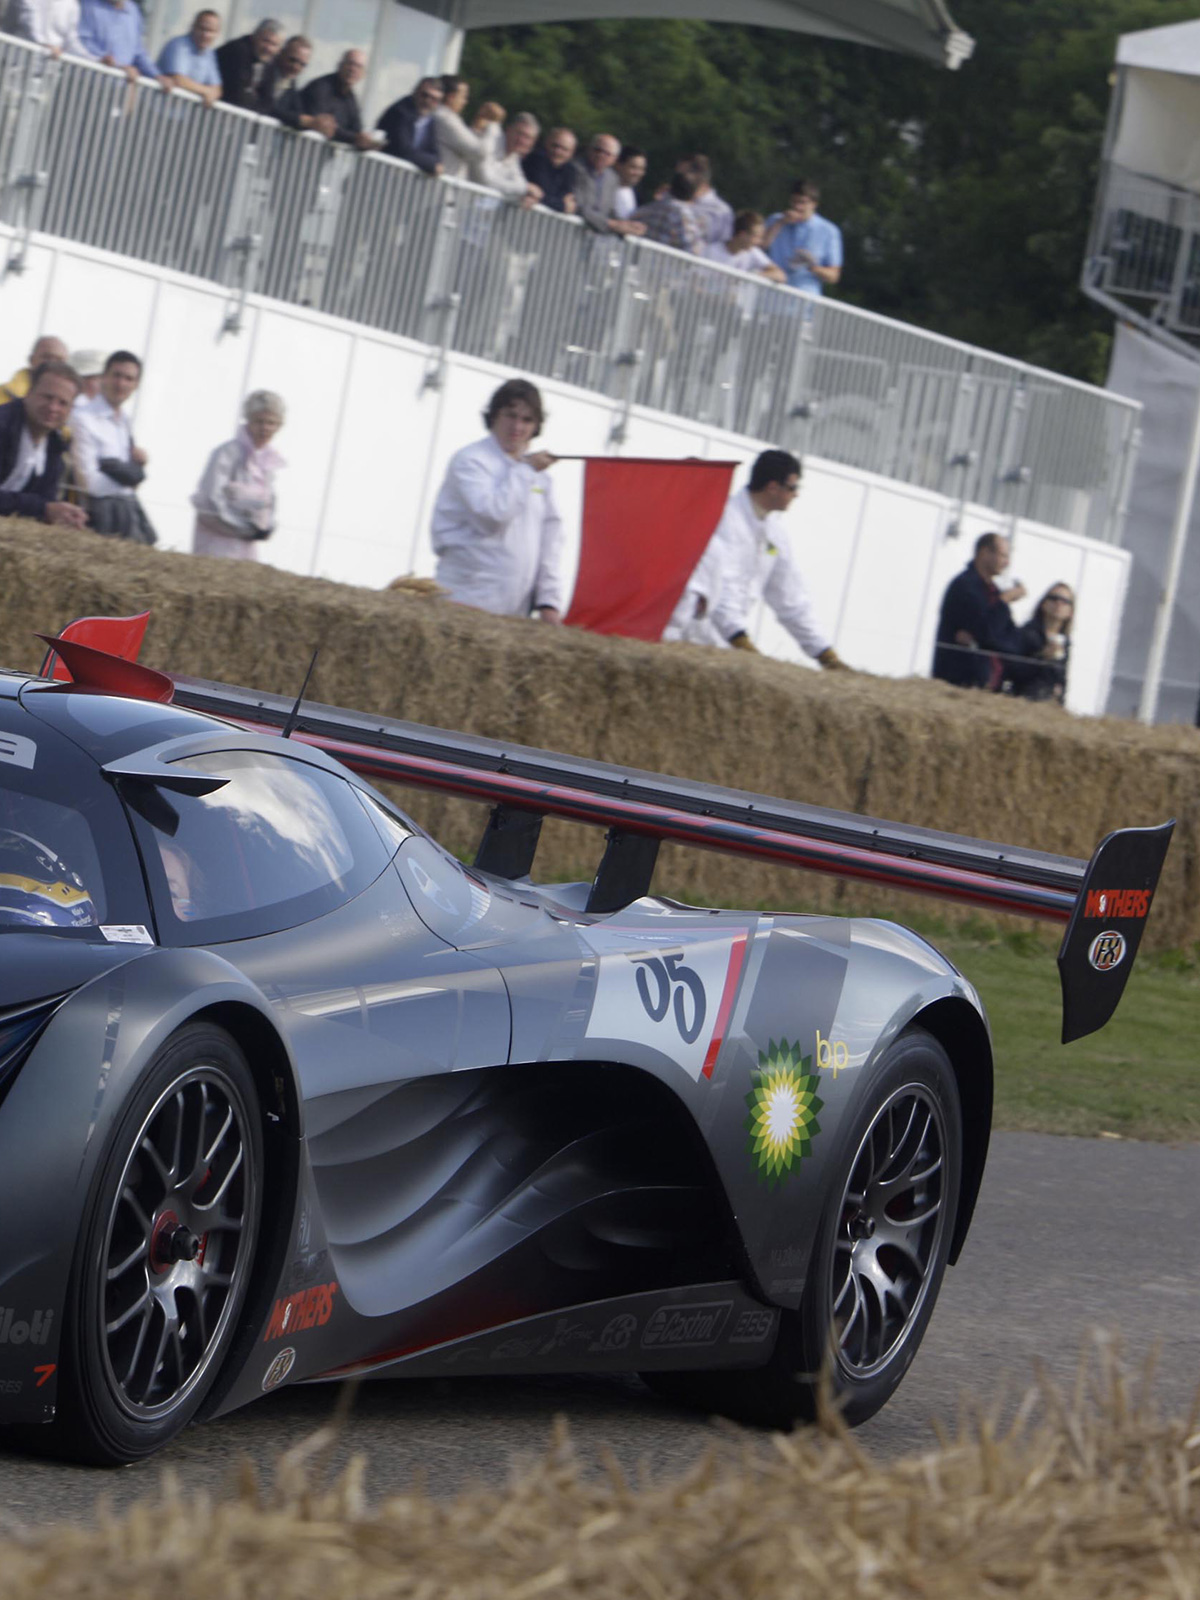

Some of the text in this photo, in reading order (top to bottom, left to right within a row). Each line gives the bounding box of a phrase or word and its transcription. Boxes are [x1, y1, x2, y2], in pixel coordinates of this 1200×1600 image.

[1084, 889, 1151, 918] MOTHERS
[816, 1030, 849, 1079] bp
[659, 1308, 722, 1342] Castrol
